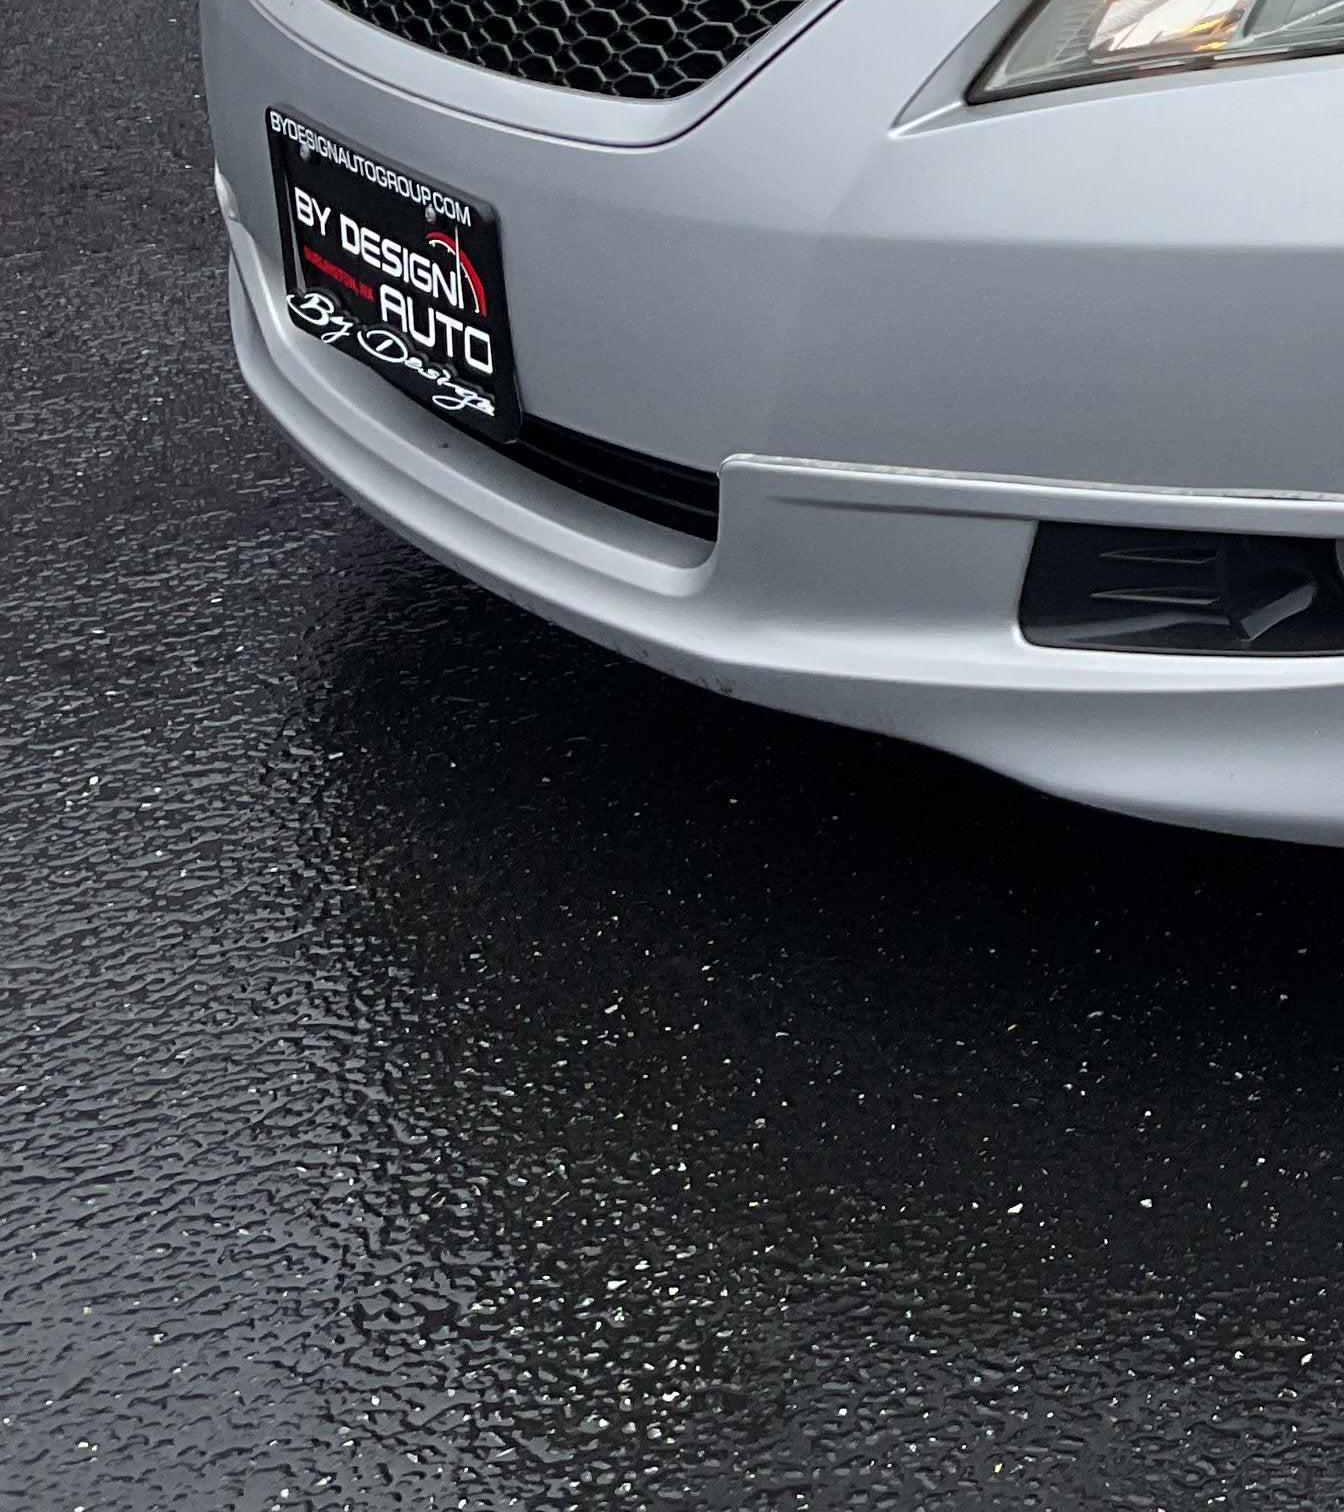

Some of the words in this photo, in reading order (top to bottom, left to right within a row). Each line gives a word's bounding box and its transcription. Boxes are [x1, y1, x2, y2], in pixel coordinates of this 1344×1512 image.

[269, 110, 472, 229] BYDESIGNAUTOGROUP.COM
[294, 186, 331, 237] BY
[339, 213, 458, 308] DESIGN
[286, 292, 354, 343] By
[356, 330, 496, 417] Design
[379, 284, 494, 375] AUTO
